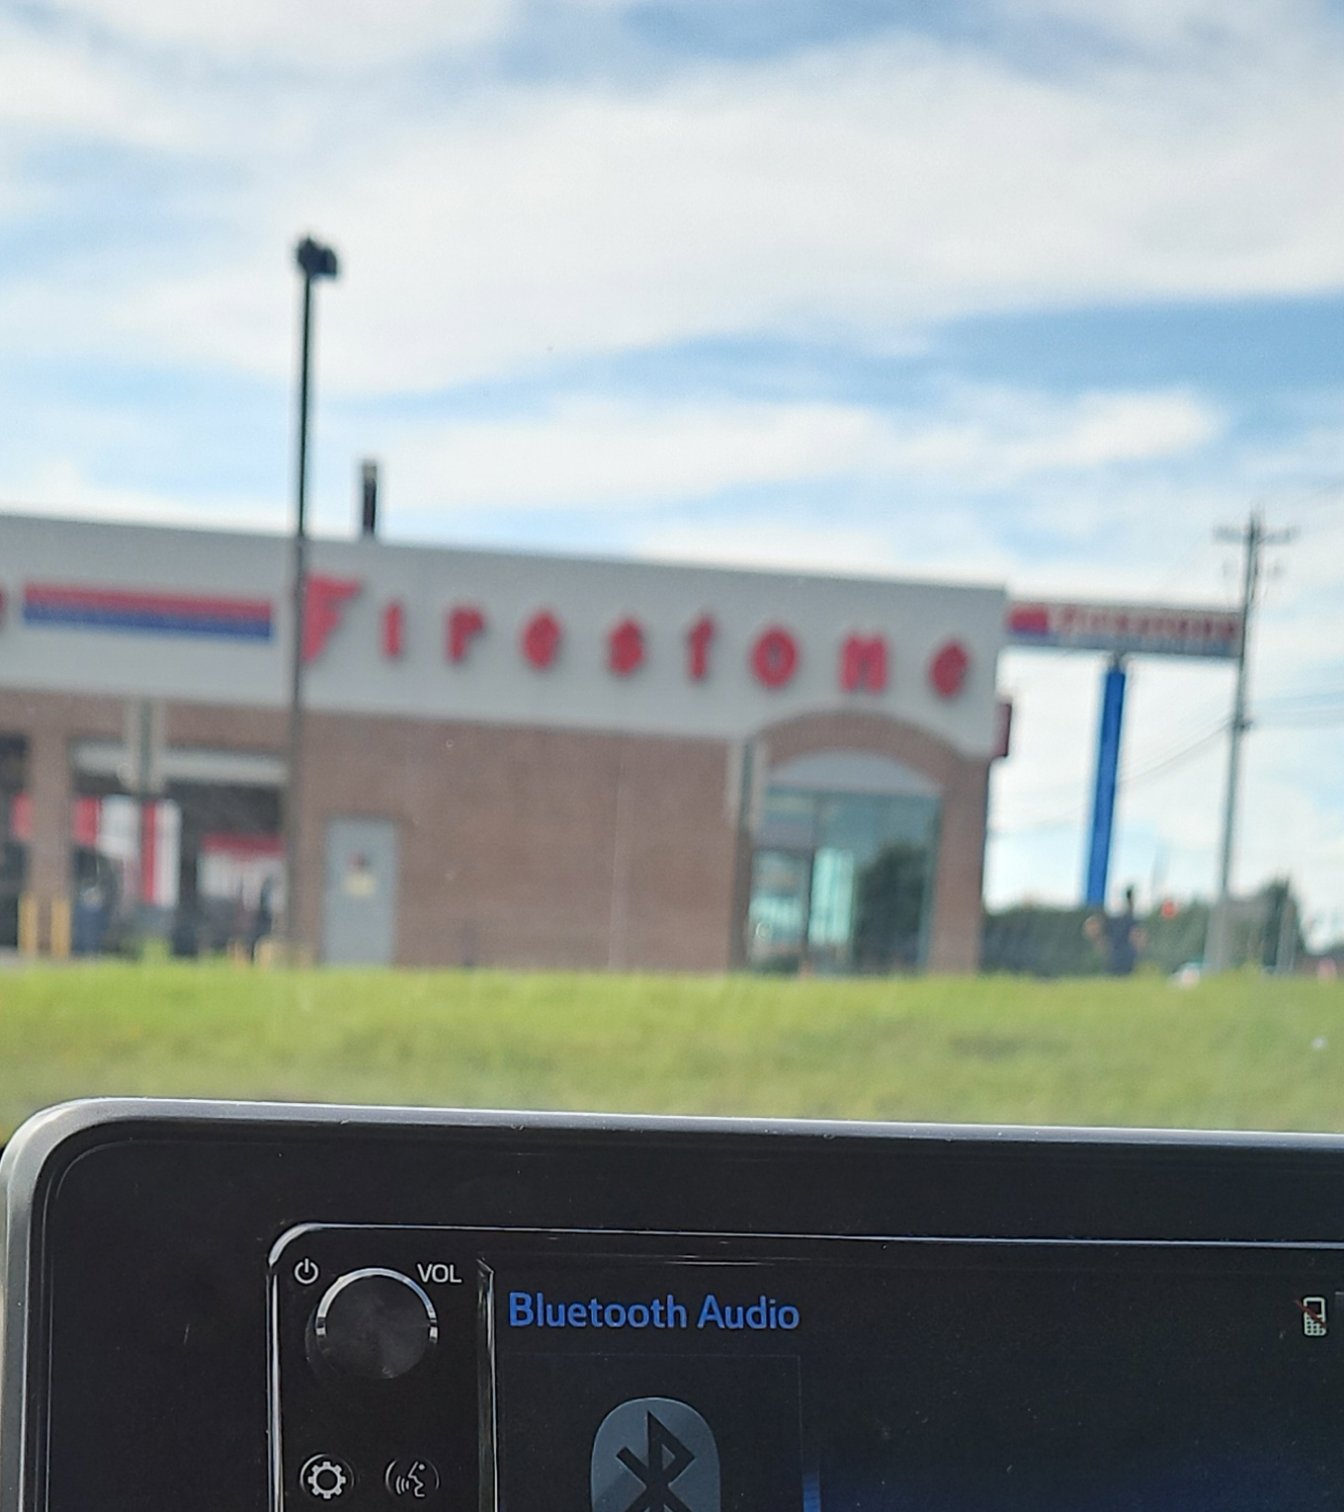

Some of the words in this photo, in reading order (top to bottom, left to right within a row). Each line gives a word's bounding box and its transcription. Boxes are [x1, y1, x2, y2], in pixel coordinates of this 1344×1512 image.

[303, 571, 970, 697] Firestone
[417, 1262, 462, 1284] VOL
[508, 1291, 689, 1329] Bluetooth
[697, 1295, 801, 1329] Audio
